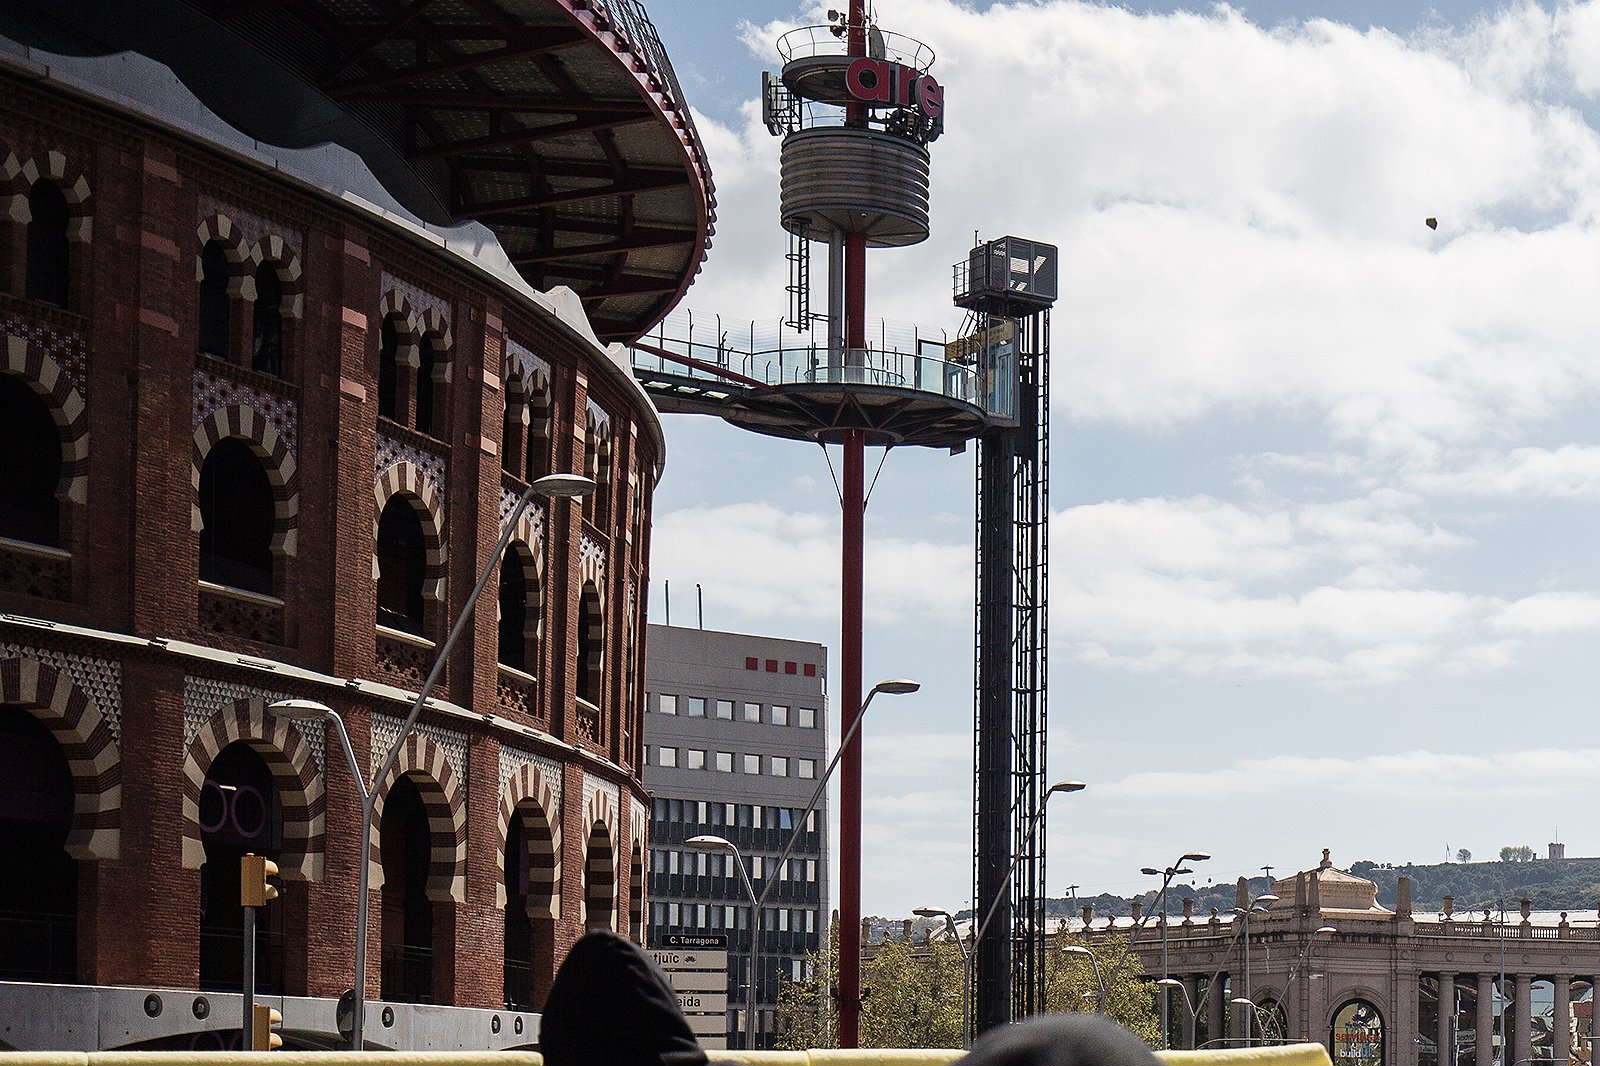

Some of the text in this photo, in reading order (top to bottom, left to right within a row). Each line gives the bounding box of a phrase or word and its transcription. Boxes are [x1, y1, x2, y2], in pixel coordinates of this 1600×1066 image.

[680, 937, 719, 946] Tarragona
[652, 952, 680, 965] tjuïc
[678, 997, 701, 1007] eida
